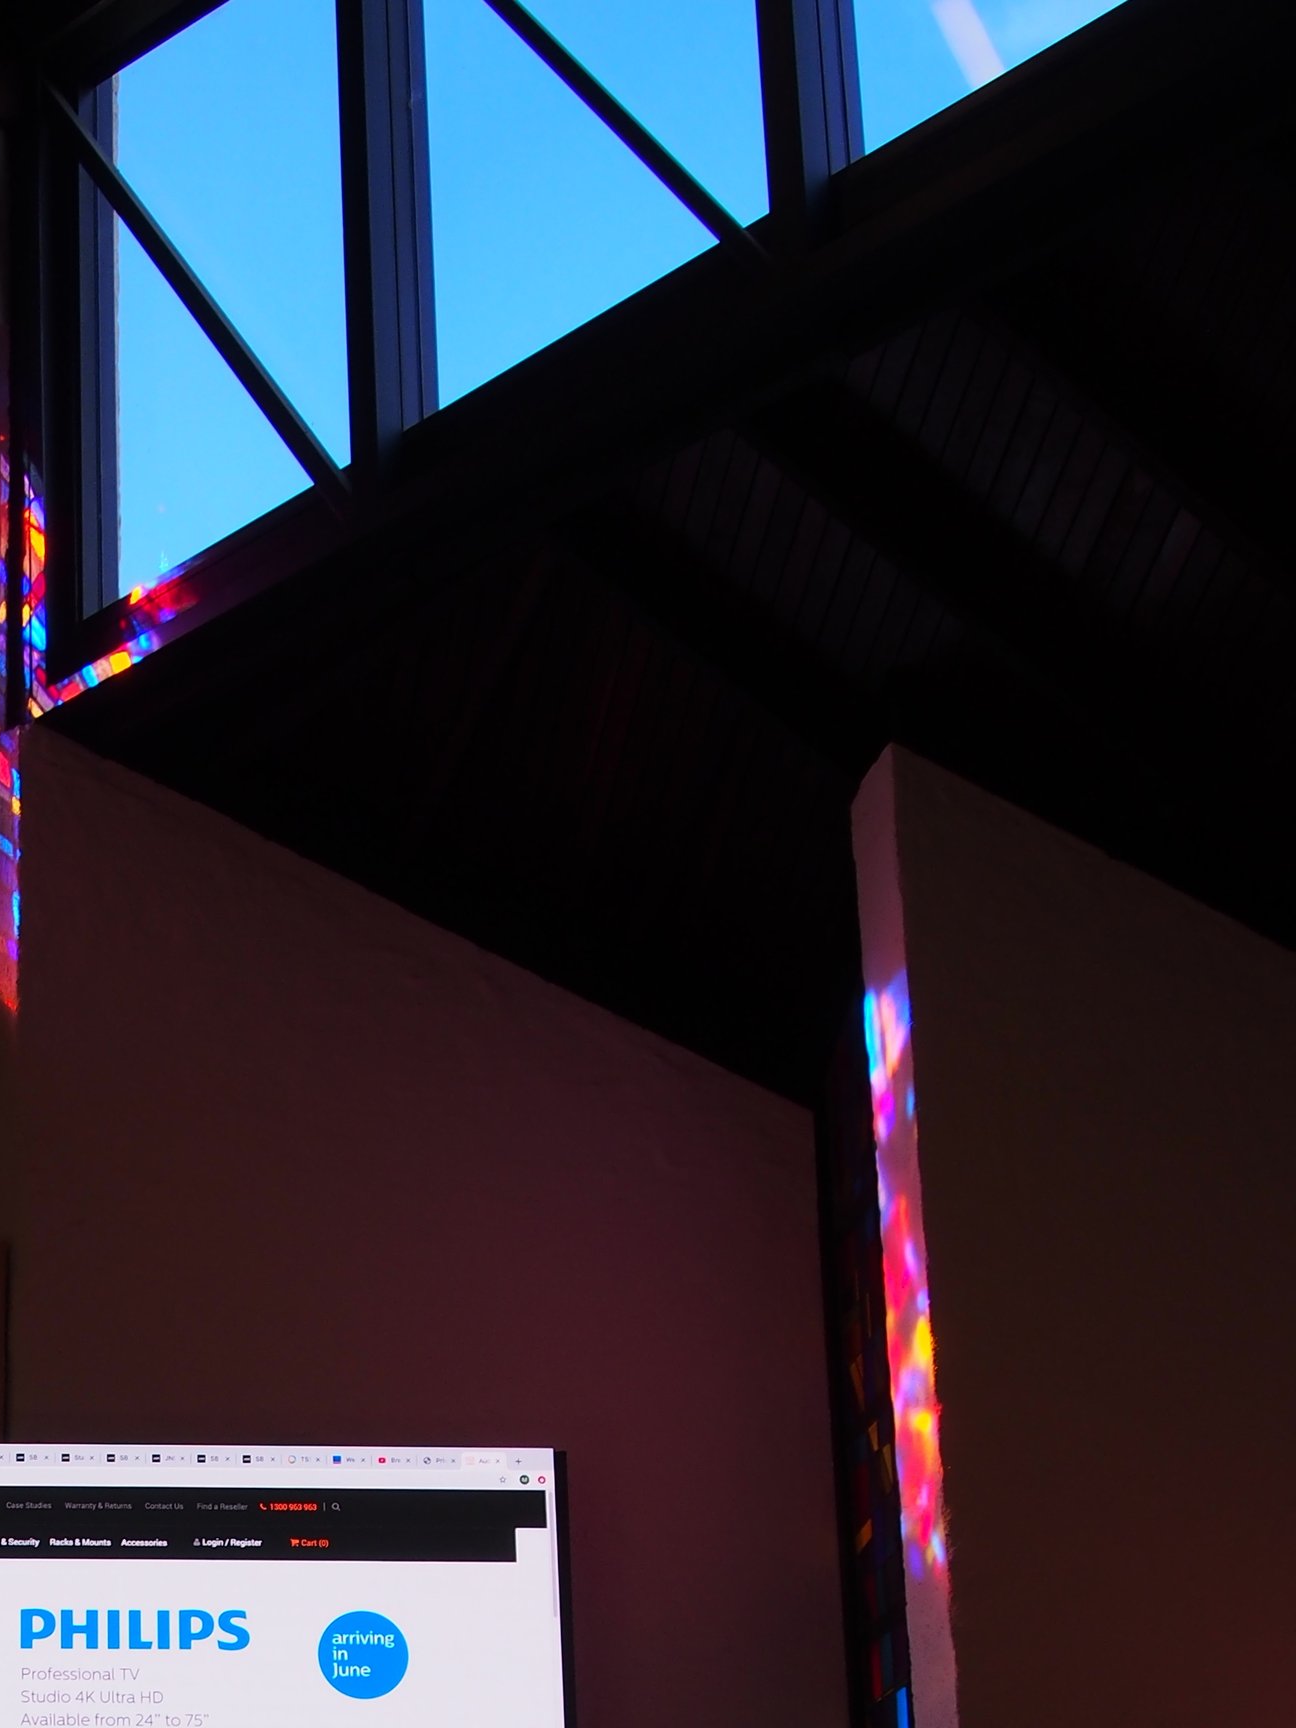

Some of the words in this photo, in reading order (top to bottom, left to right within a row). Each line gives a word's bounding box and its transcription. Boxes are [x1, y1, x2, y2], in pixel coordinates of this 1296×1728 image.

[6, 1501, 23, 1509] Case
[25, 1501, 52, 1509] Studies
[65, 1501, 96, 1511] Warranty
[105, 1501, 132, 1510] Returns
[144, 1502, 171, 1510] Contact
[173, 1502, 184, 1510] Us
[270, 1503, 287, 1511] 1300
[8, 1537, 40, 1548] Security
[49, 1538, 74, 1547] Racks
[74, 1538, 81, 1547] &
[82, 1538, 112, 1547] Mounts
[120, 1538, 168, 1547] Accessories
[202, 1538, 224, 1548] Login
[230, 1538, 262, 1548] Register
[301, 1539, 317, 1547] Cart
[319, 1539, 329, 1548] (0)
[19, 1608, 251, 1651] PHILIPS
[332, 1630, 395, 1649] arriving
[332, 1646, 348, 1661] in
[20, 1667, 115, 1681] Professional
[120, 1667, 140, 1681] TV
[332, 1662, 371, 1679] June
[20, 1690, 71, 1704] Studio
[75, 1690, 95, 1704] 4K
[99, 1690, 136, 1704] Ultra
[140, 1690, 164, 1704] HD
[20, 1713, 90, 1727] Available
[95, 1714, 131, 1727] from
[165, 1715, 181, 1727] to
